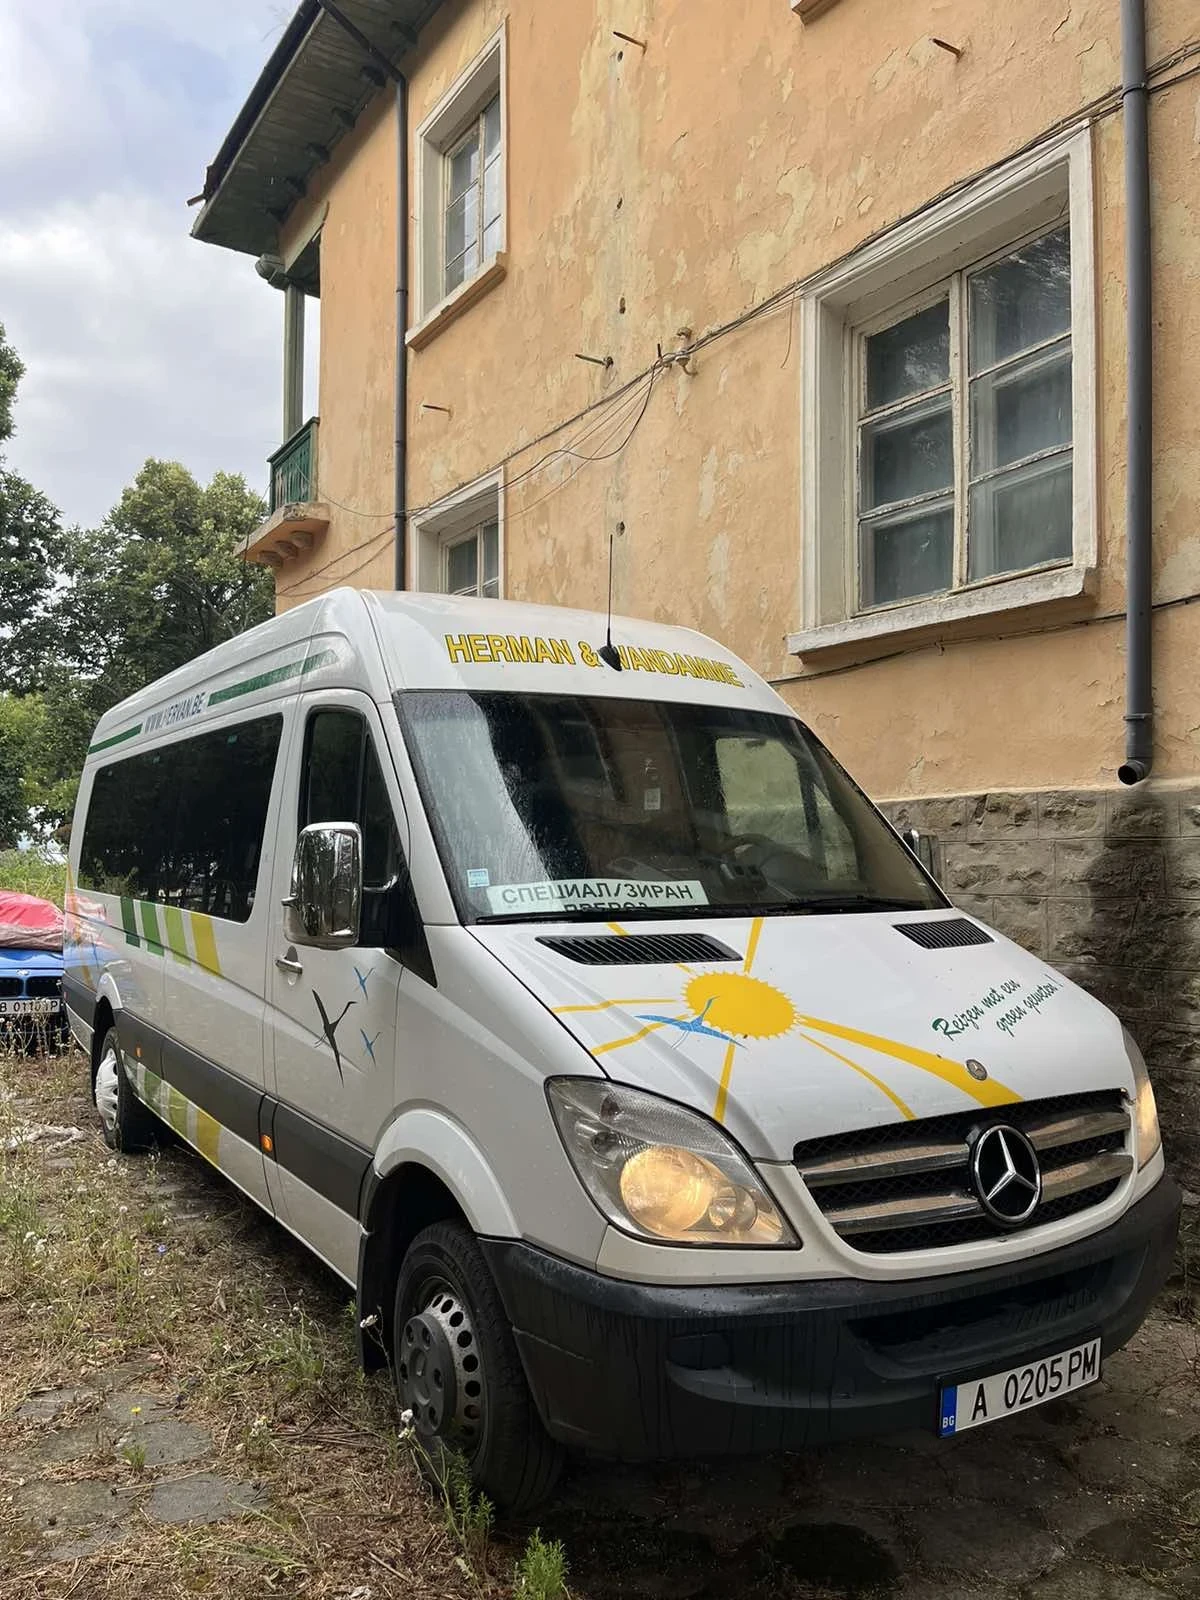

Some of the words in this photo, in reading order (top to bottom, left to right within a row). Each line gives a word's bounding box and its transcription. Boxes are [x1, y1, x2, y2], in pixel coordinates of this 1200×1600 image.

[445, 634, 576, 665] HERMAN
[577, 641, 604, 667] &
[932, 1005, 985, 1041] Reizen
[981, 987, 1004, 1008] met
[1000, 979, 1021, 994] een
[996, 1005, 1027, 1037] groen
[971, 1383, 988, 1421] A
[1004, 1356, 1063, 1409] 0205
[1067, 1343, 1097, 1387] PM
[942, 1415, 955, 1429] BG
